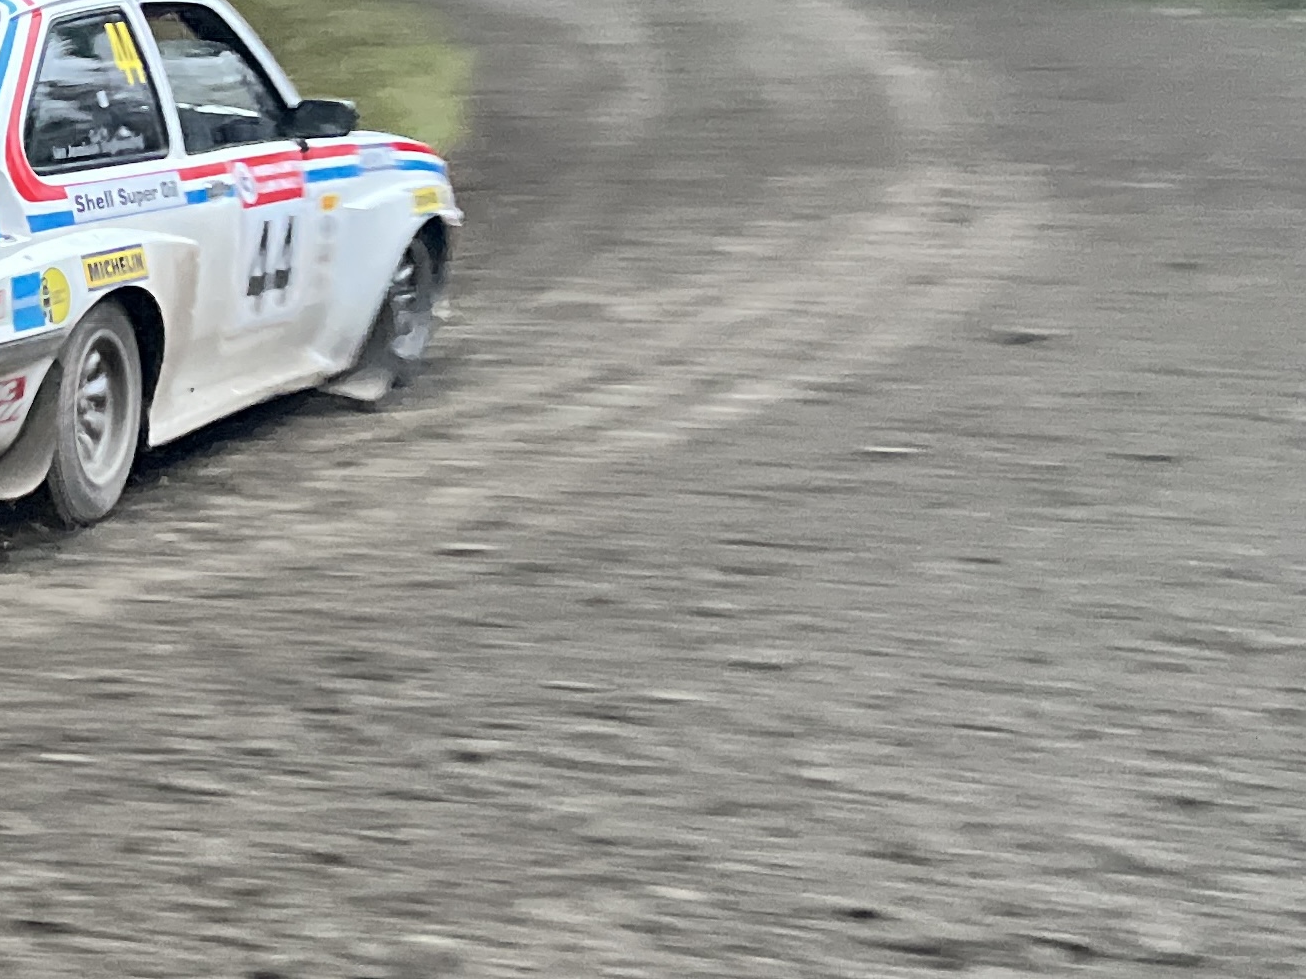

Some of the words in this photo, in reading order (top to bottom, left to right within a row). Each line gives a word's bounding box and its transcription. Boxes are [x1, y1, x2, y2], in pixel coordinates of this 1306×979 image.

[104, 22, 147, 86] 44
[75, 189, 115, 213] Shell
[117, 186, 159, 207] Super
[87, 253, 145, 283] MICHELIN
[247, 216, 294, 313] 44
